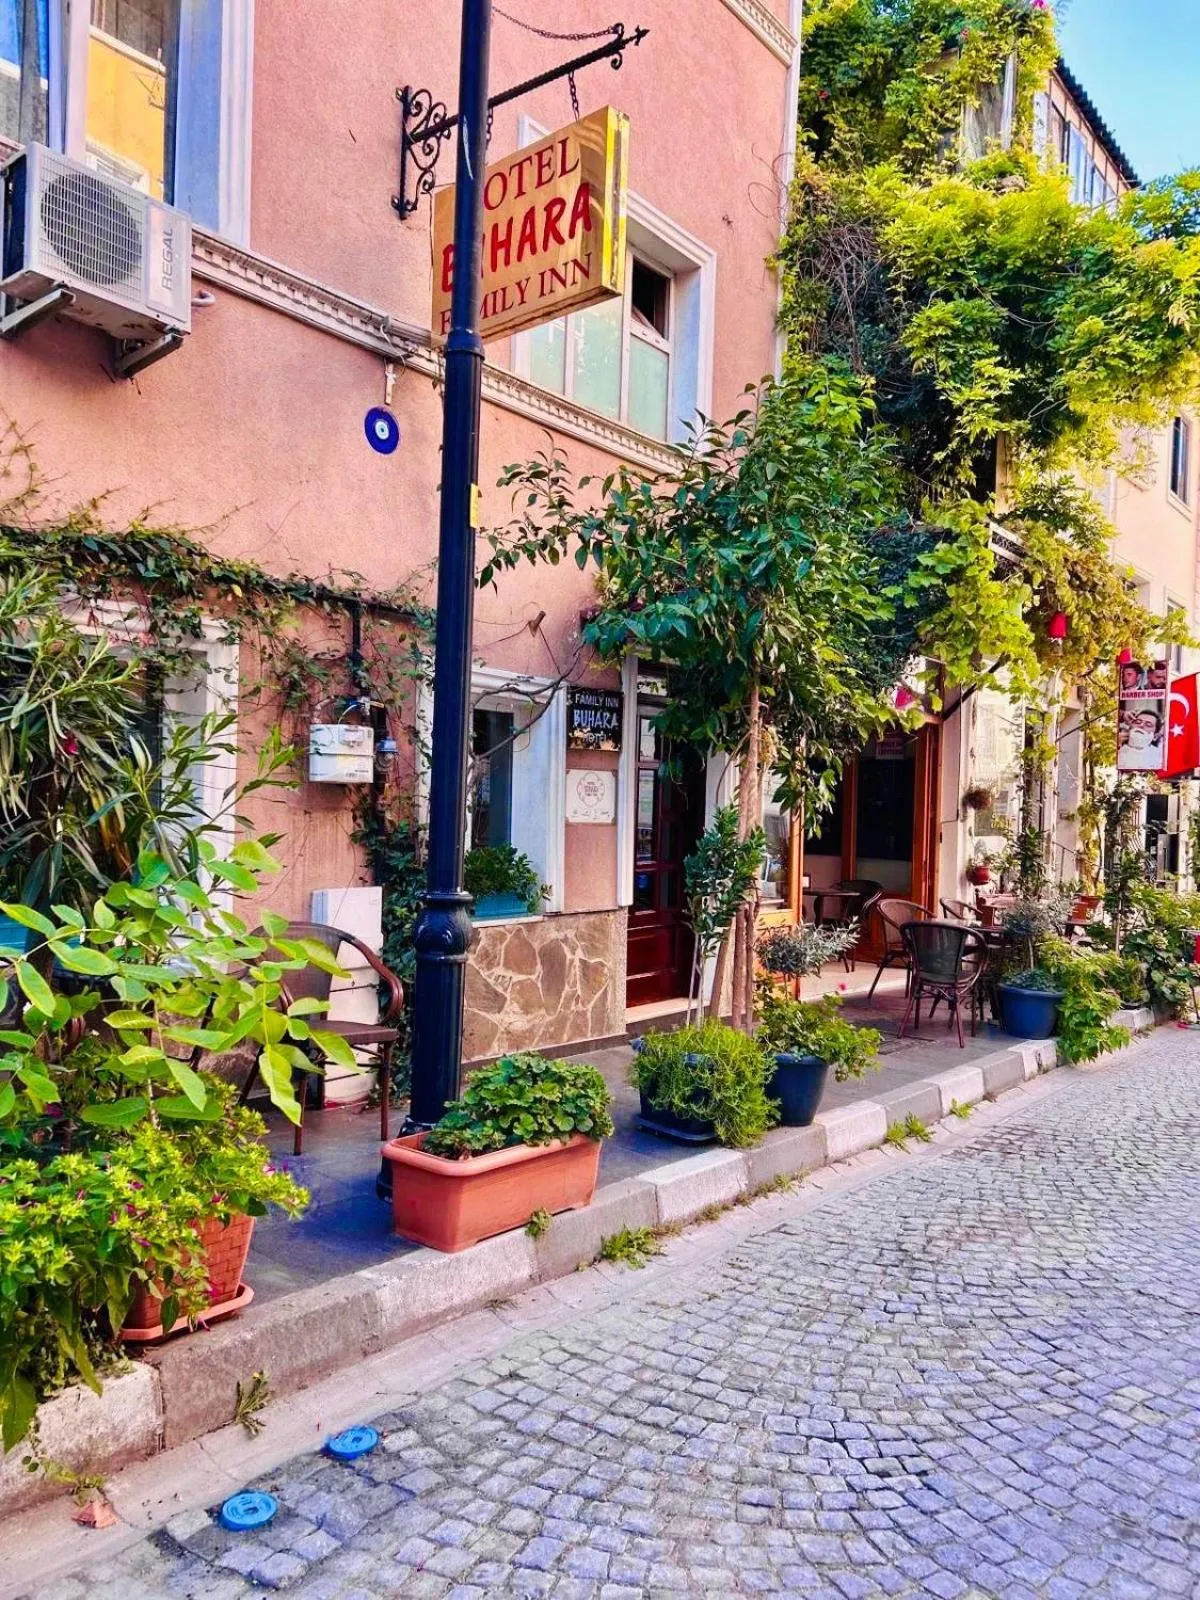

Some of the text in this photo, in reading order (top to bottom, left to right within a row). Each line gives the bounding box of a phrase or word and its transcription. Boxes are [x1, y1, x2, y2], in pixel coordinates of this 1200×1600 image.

[484, 136, 580, 211] OTEL
[161, 228, 174, 290] REGAL
[441, 182, 593, 293] BHARA
[440, 251, 593, 336] FMILY INN
[573, 709, 619, 730] BUHARA
[575, 693, 619, 708] FAMILY INN
[1147, 690, 1164, 698] SHOP
